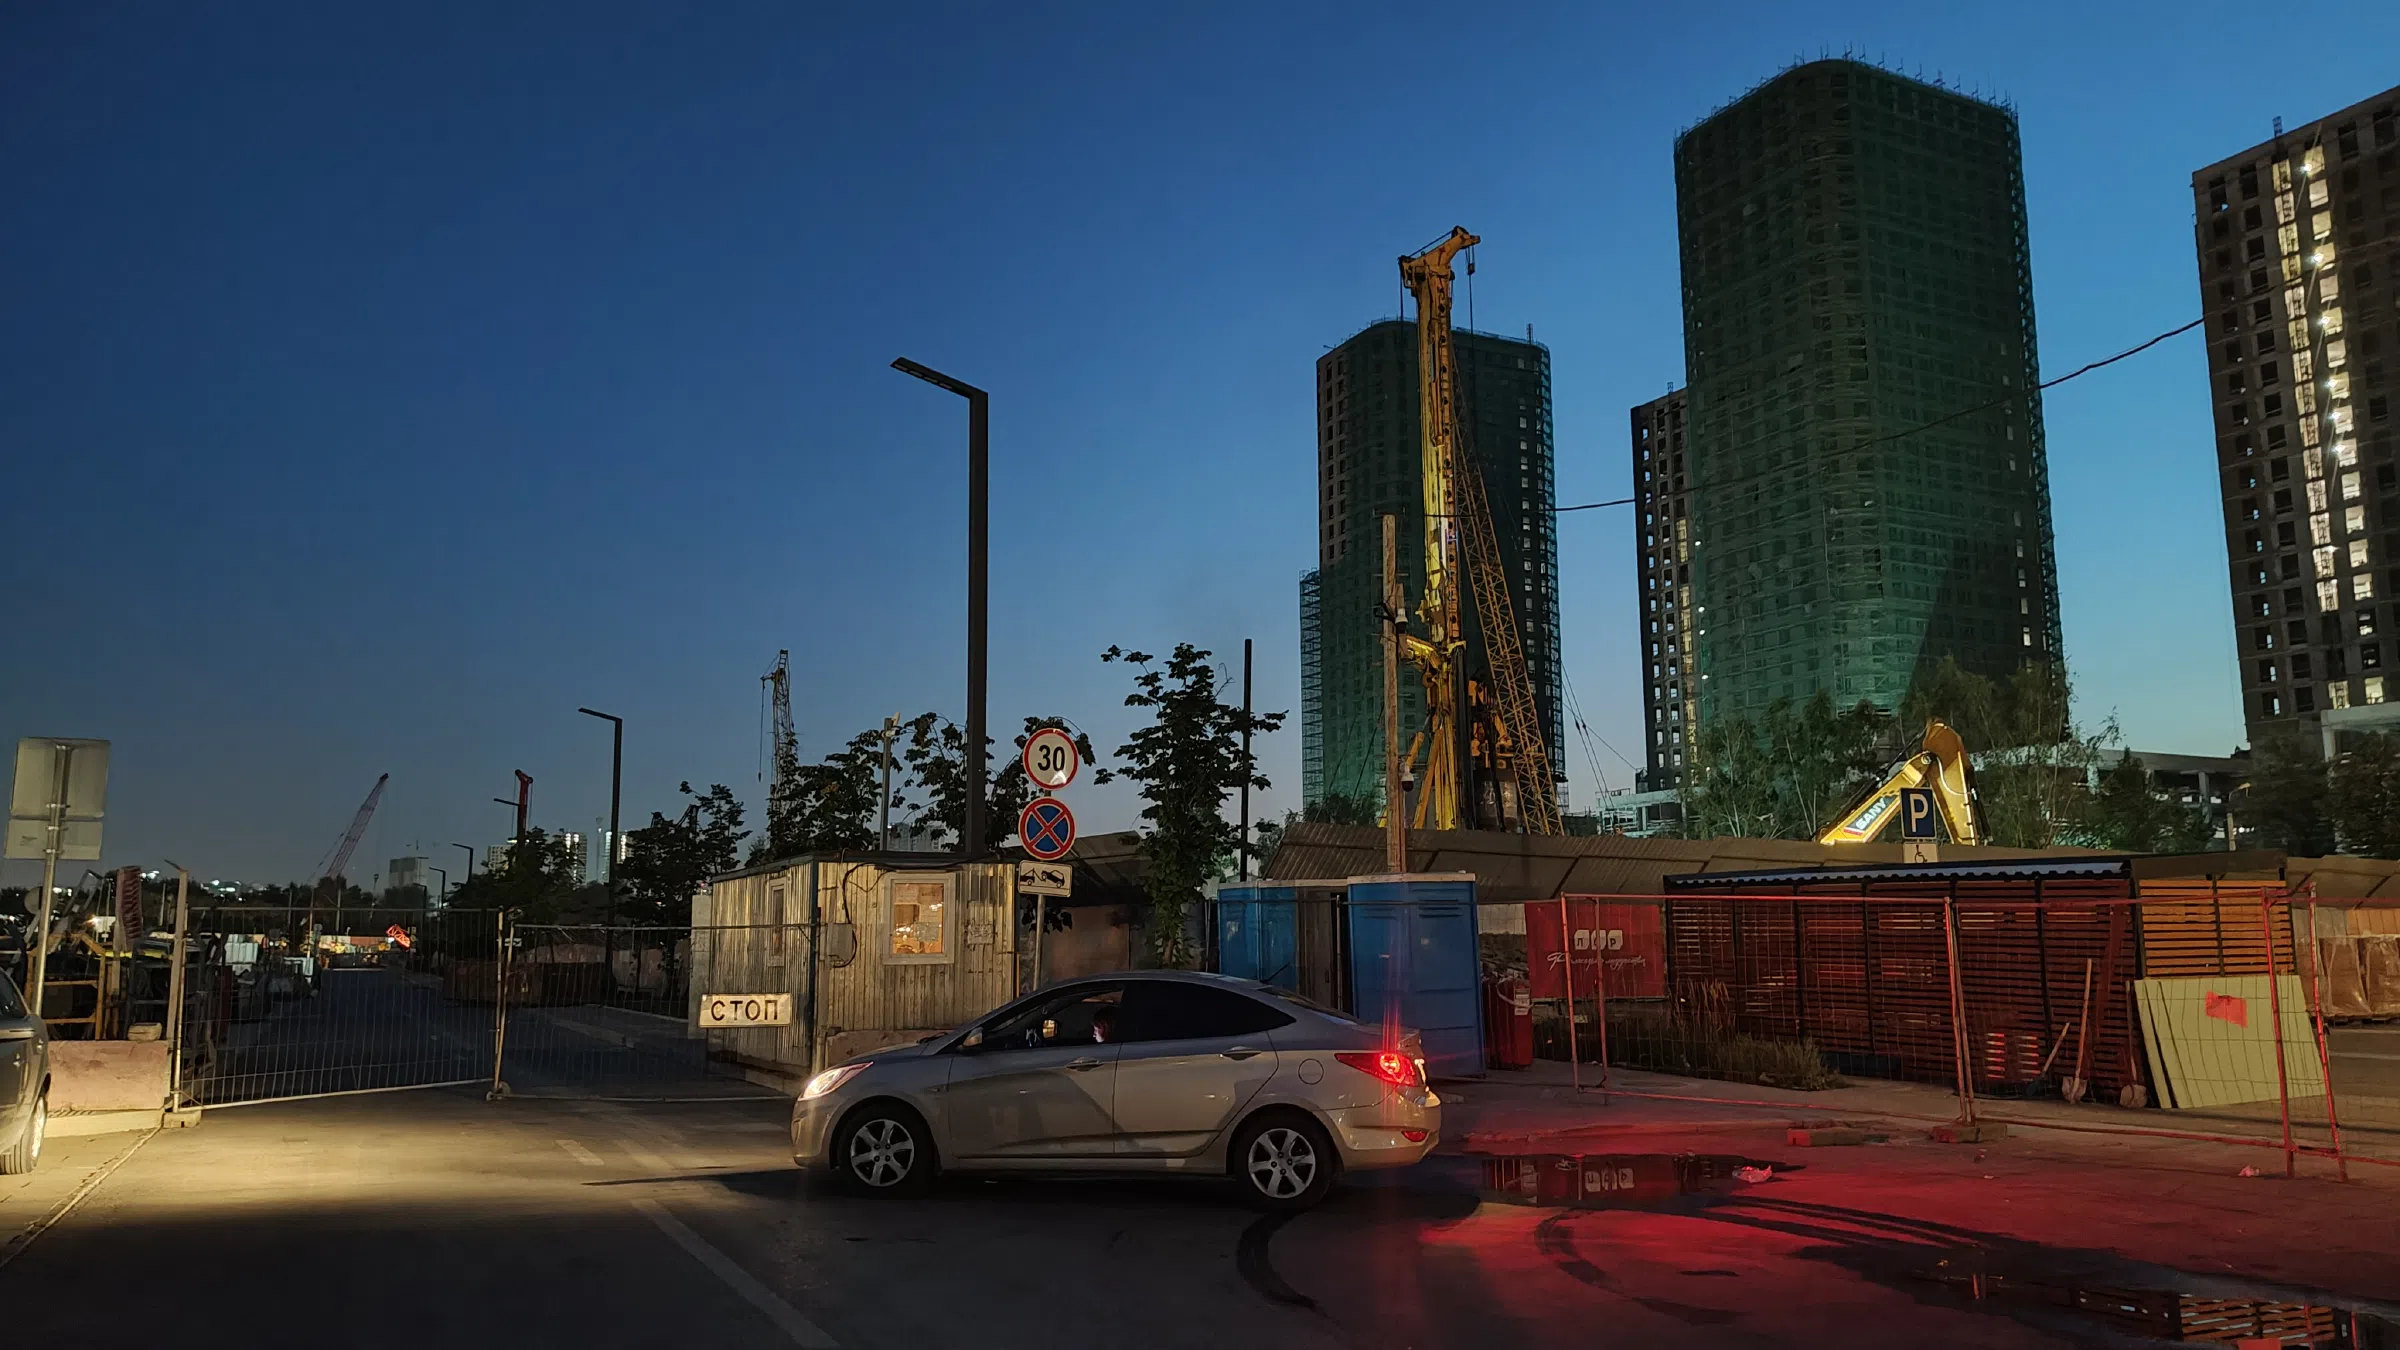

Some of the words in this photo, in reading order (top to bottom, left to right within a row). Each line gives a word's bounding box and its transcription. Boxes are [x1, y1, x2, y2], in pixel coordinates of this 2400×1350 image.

[1037, 744, 1066, 771] 30
[1855, 797, 1887, 830] SANY
[1909, 793, 1929, 833] P
[711, 1000, 778, 1021] СТОП
